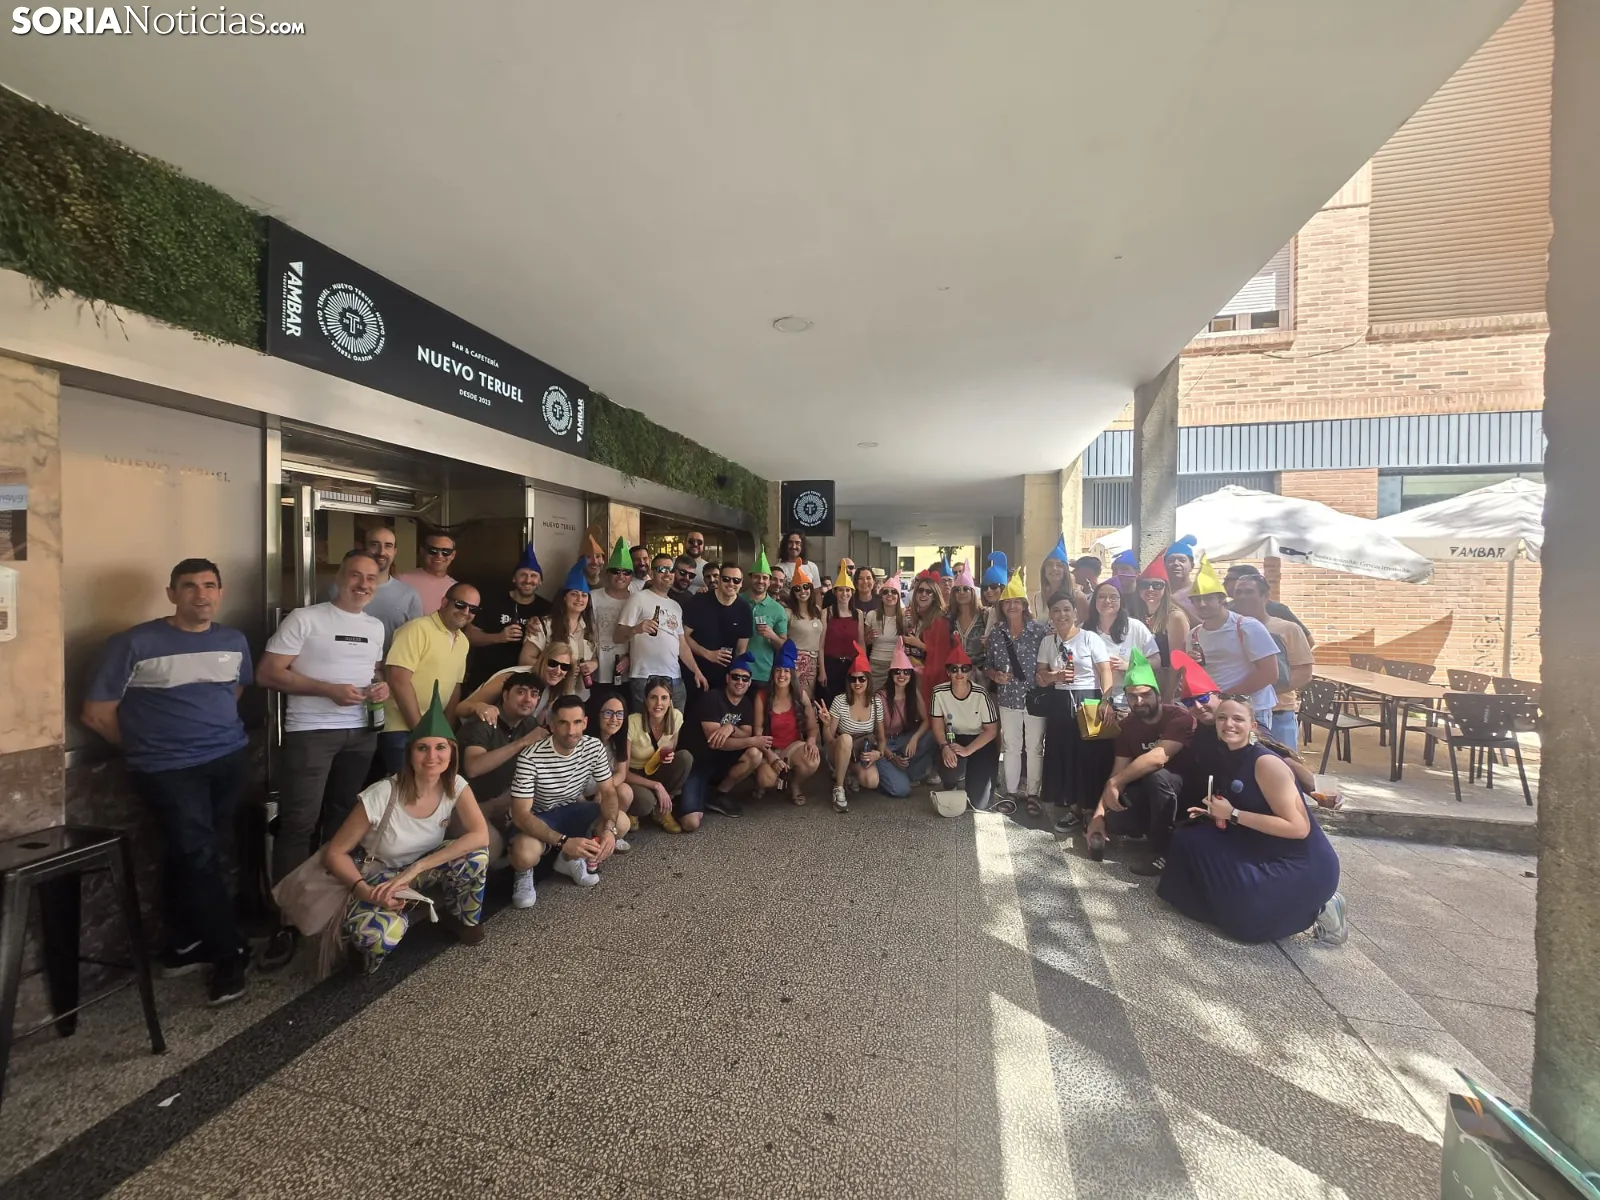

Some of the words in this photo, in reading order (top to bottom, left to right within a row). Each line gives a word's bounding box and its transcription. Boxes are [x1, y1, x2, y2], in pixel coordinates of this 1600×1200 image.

[286, 271, 302, 337] AMBAR
[452, 341, 464, 352] BAR
[470, 350, 499, 368] CAFETERÍA
[417, 344, 474, 382] NUEVO
[479, 371, 524, 403] TERUEL
[459, 388, 478, 401] DESDE
[1457, 546, 1506, 558] AMBAR
